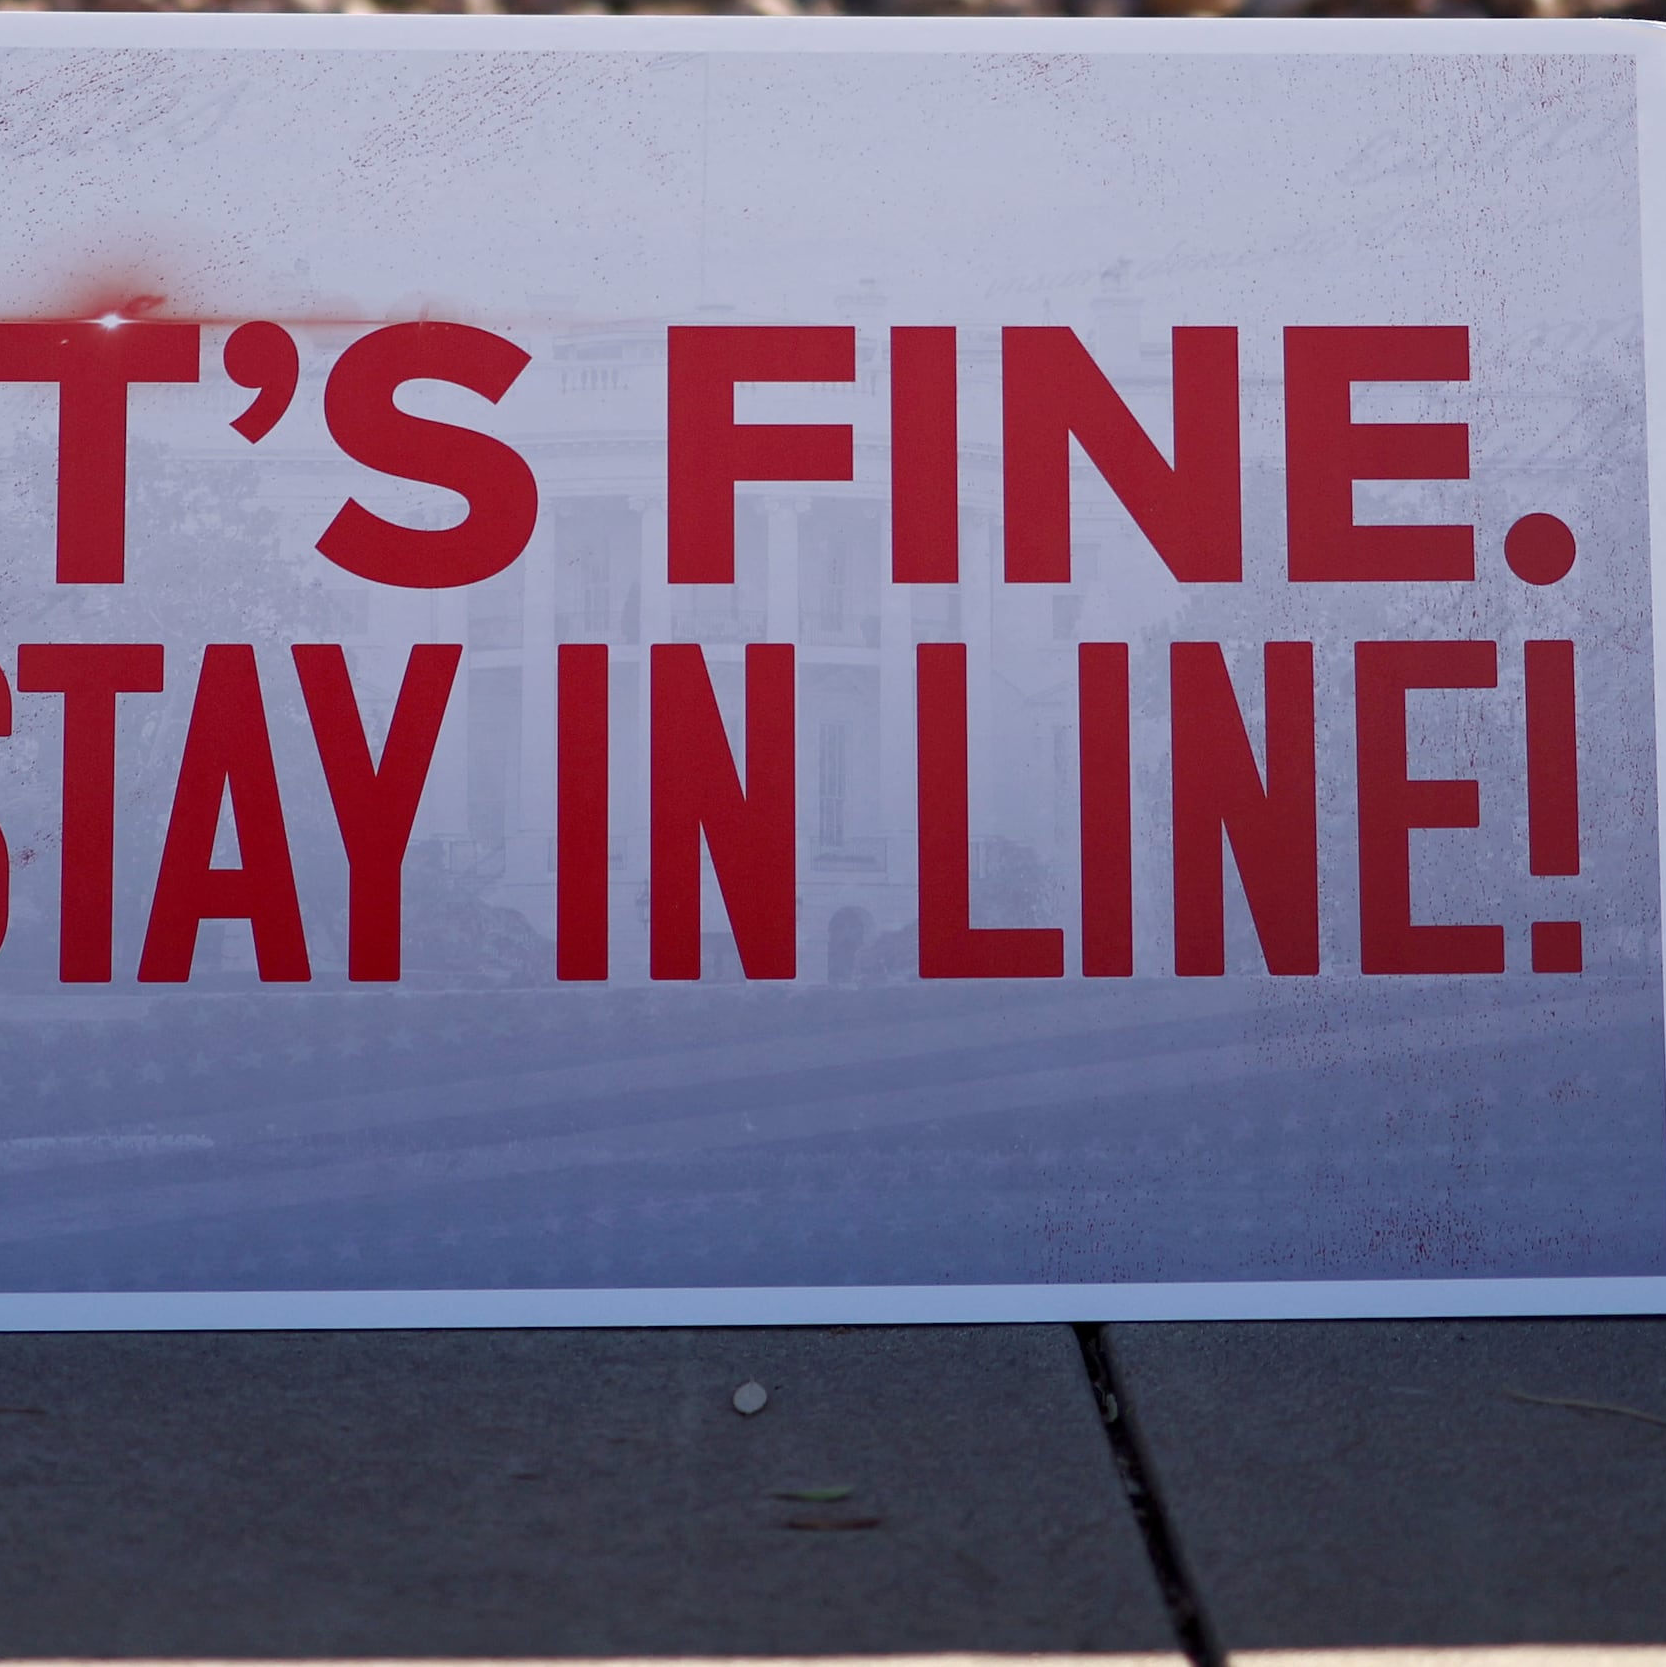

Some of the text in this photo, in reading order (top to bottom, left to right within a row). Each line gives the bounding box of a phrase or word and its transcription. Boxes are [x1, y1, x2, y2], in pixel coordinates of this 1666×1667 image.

[667, 324, 1577, 586] FINE.
[557, 642, 797, 982] IN
[916, 639, 1583, 979] LINE!
